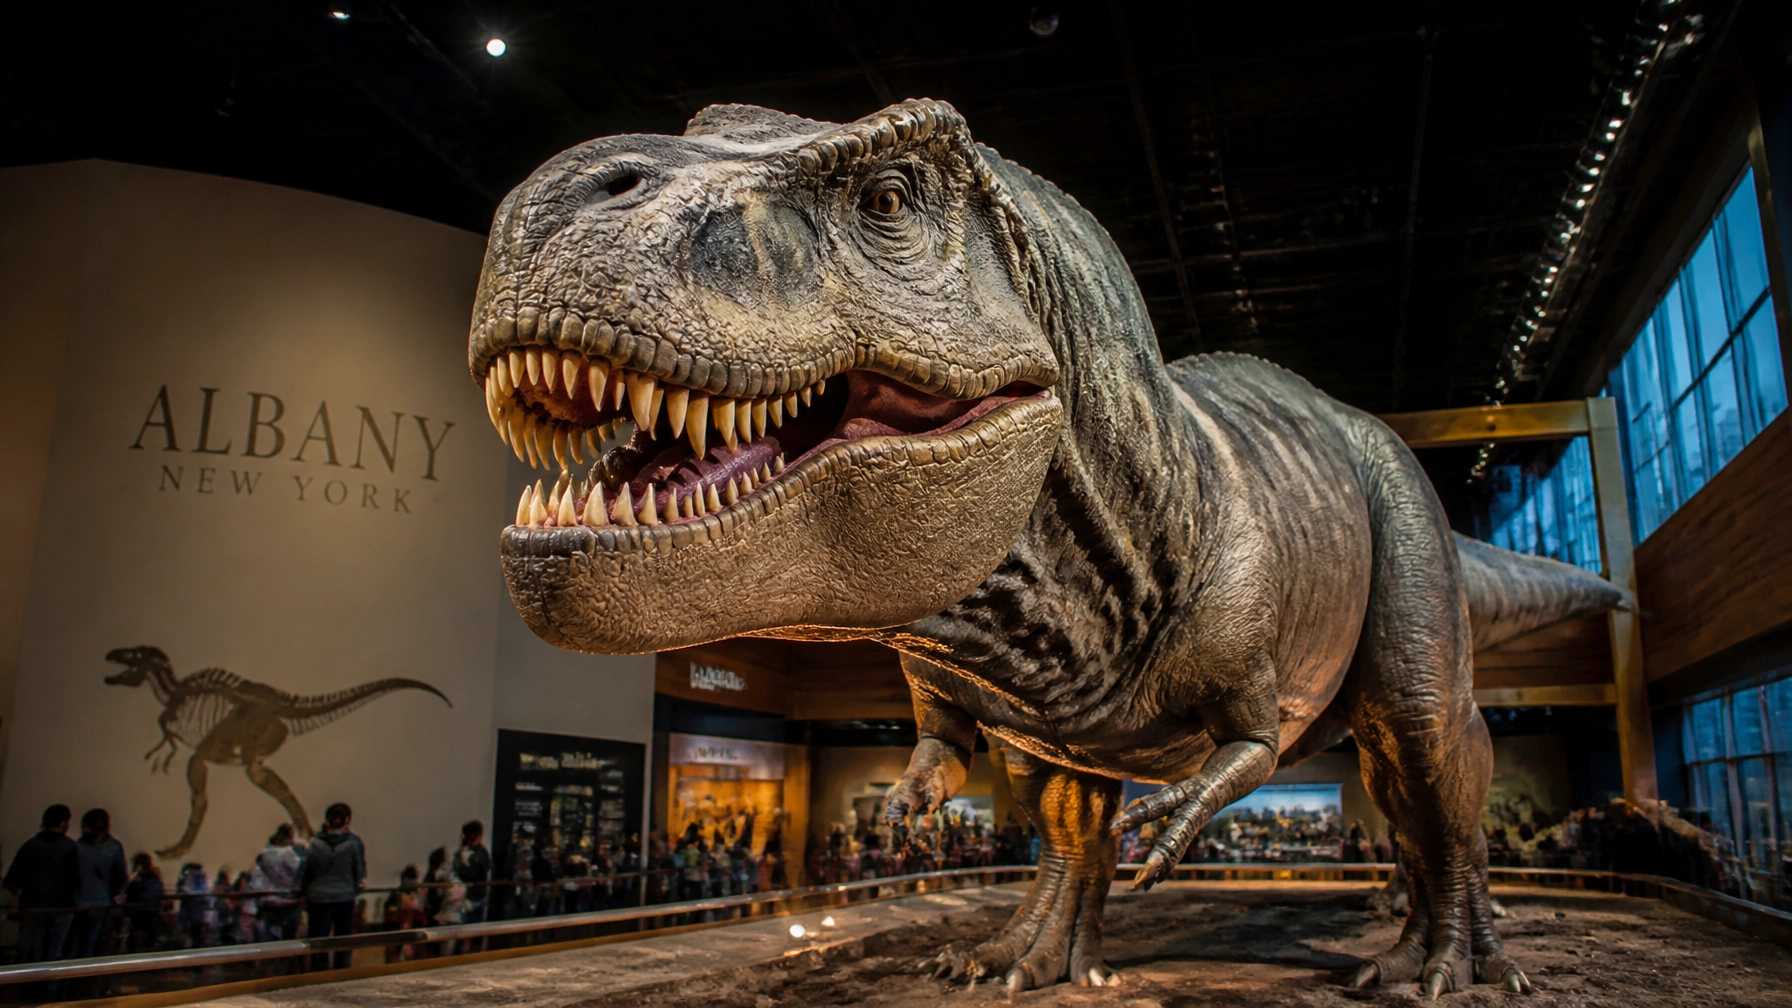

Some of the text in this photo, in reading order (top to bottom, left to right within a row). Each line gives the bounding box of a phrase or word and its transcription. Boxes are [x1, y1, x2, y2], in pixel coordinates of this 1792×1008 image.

[128, 383, 455, 482] ALBANY
[159, 465, 411, 514] NEW YORK
